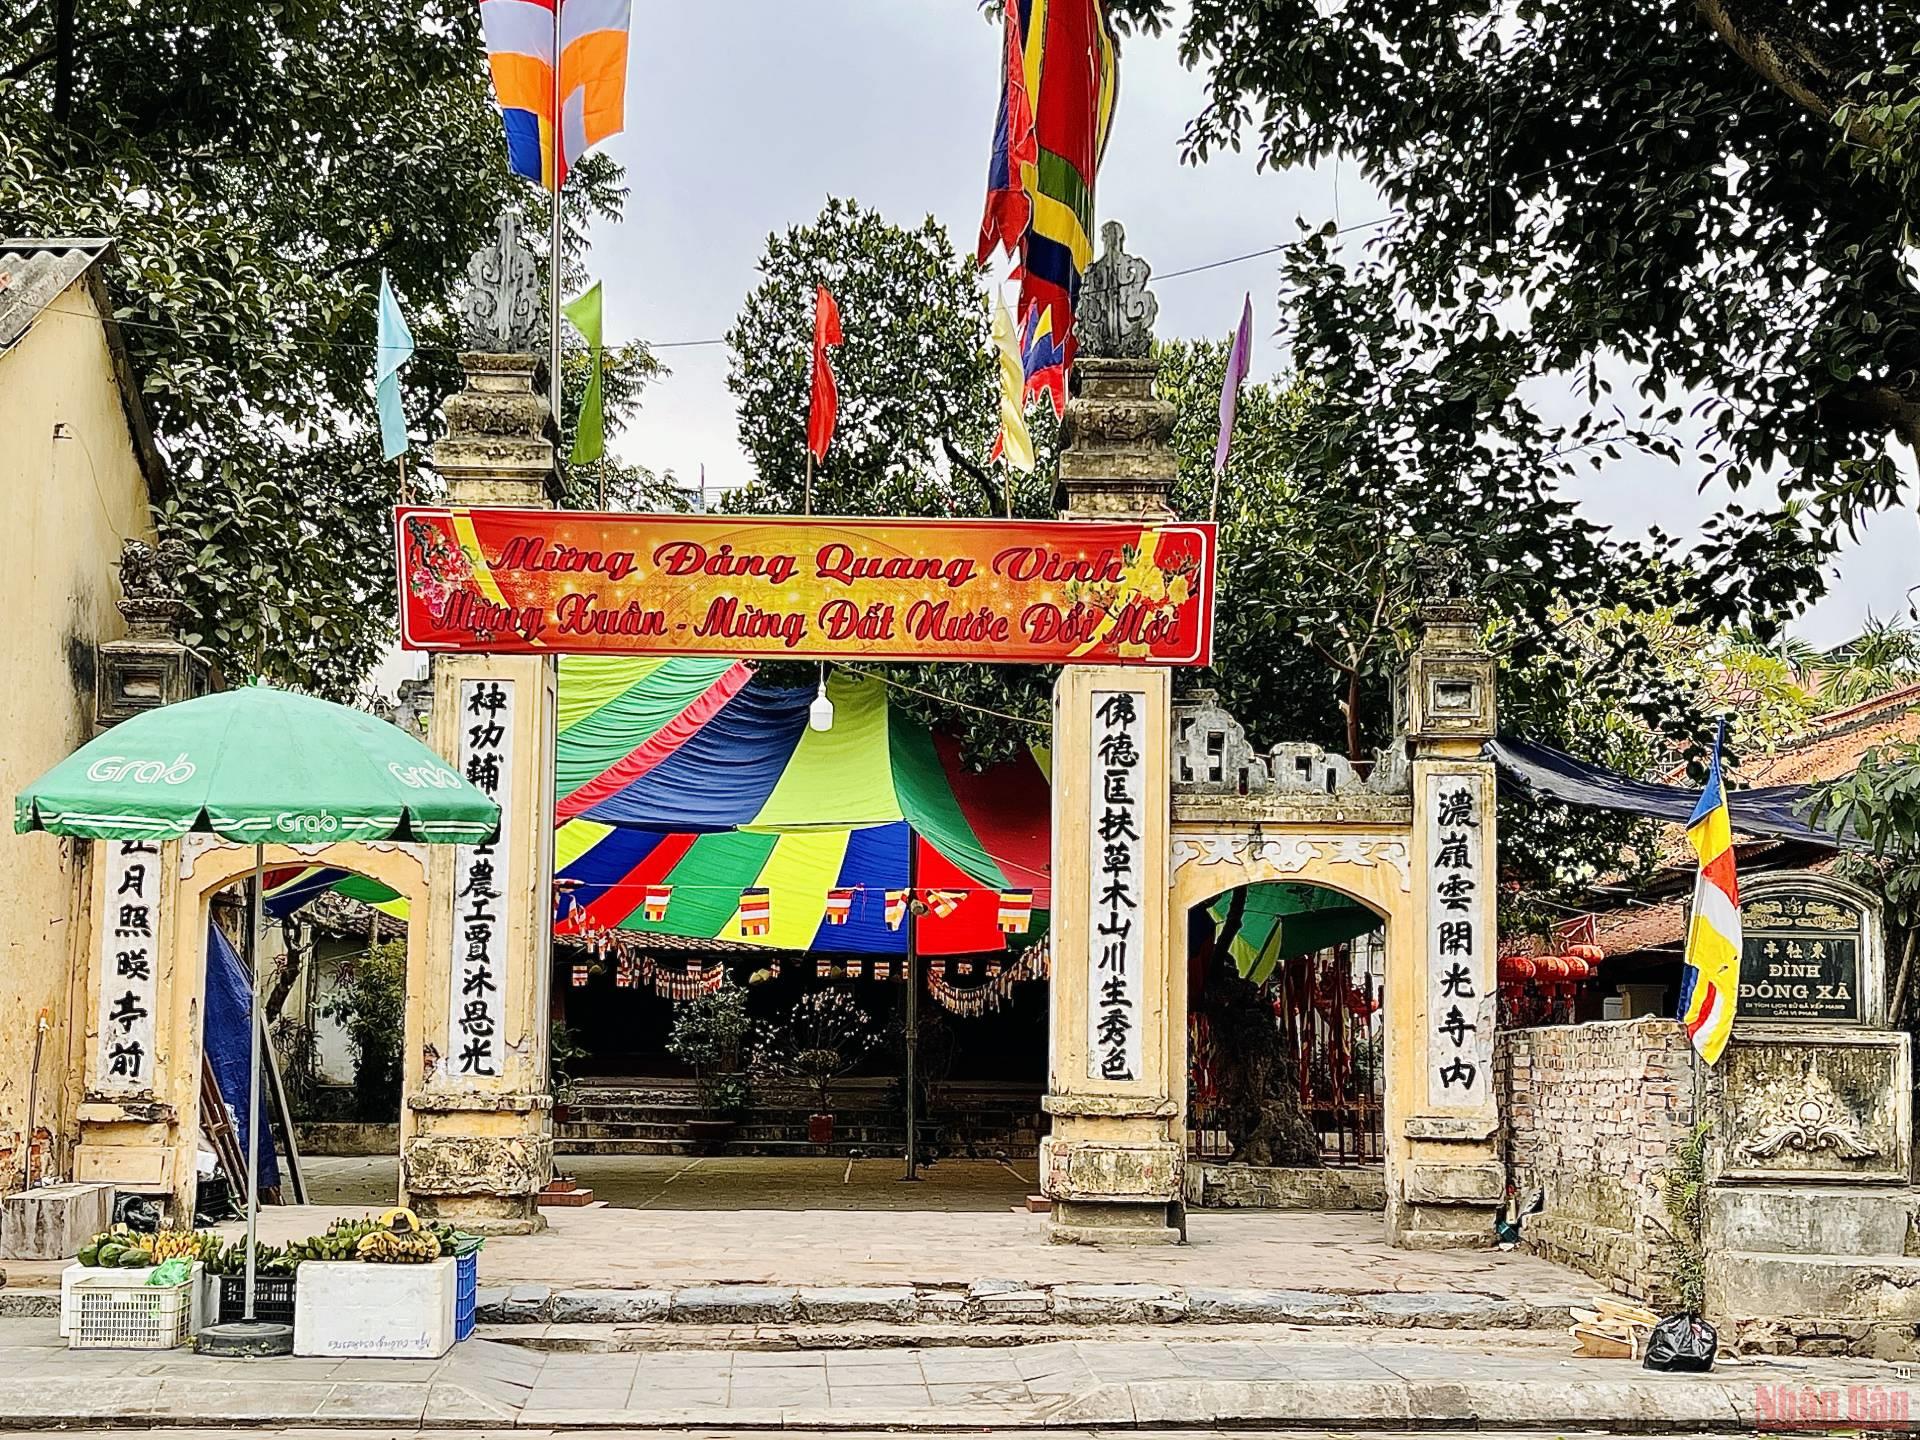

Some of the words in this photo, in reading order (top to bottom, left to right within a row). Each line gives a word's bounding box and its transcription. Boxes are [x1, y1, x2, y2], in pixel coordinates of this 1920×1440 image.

[487, 536, 638, 581] Mừng
[653, 540, 800, 585] Đảng
[816, 543, 977, 588] Quang
[993, 546, 1127, 584] Vinh
[432, 589, 547, 641] Mừng
[556, 593, 668, 636] Xuân
[695, 597, 808, 648] Mừng
[818, 599, 895, 641] Đất
[906, 599, 1010, 643] Nước
[1019, 602, 1096, 645] Đổi
[1101, 604, 1181, 646] Mới
[86, 752, 197, 786] Grab
[387, 759, 465, 791] Grab
[276, 808, 338, 834] Grab
[1768, 960, 1821, 978] ĐÌNH
[1739, 979, 1809, 999] ĐÔNG
[1816, 982, 1852, 1000] XÃ
